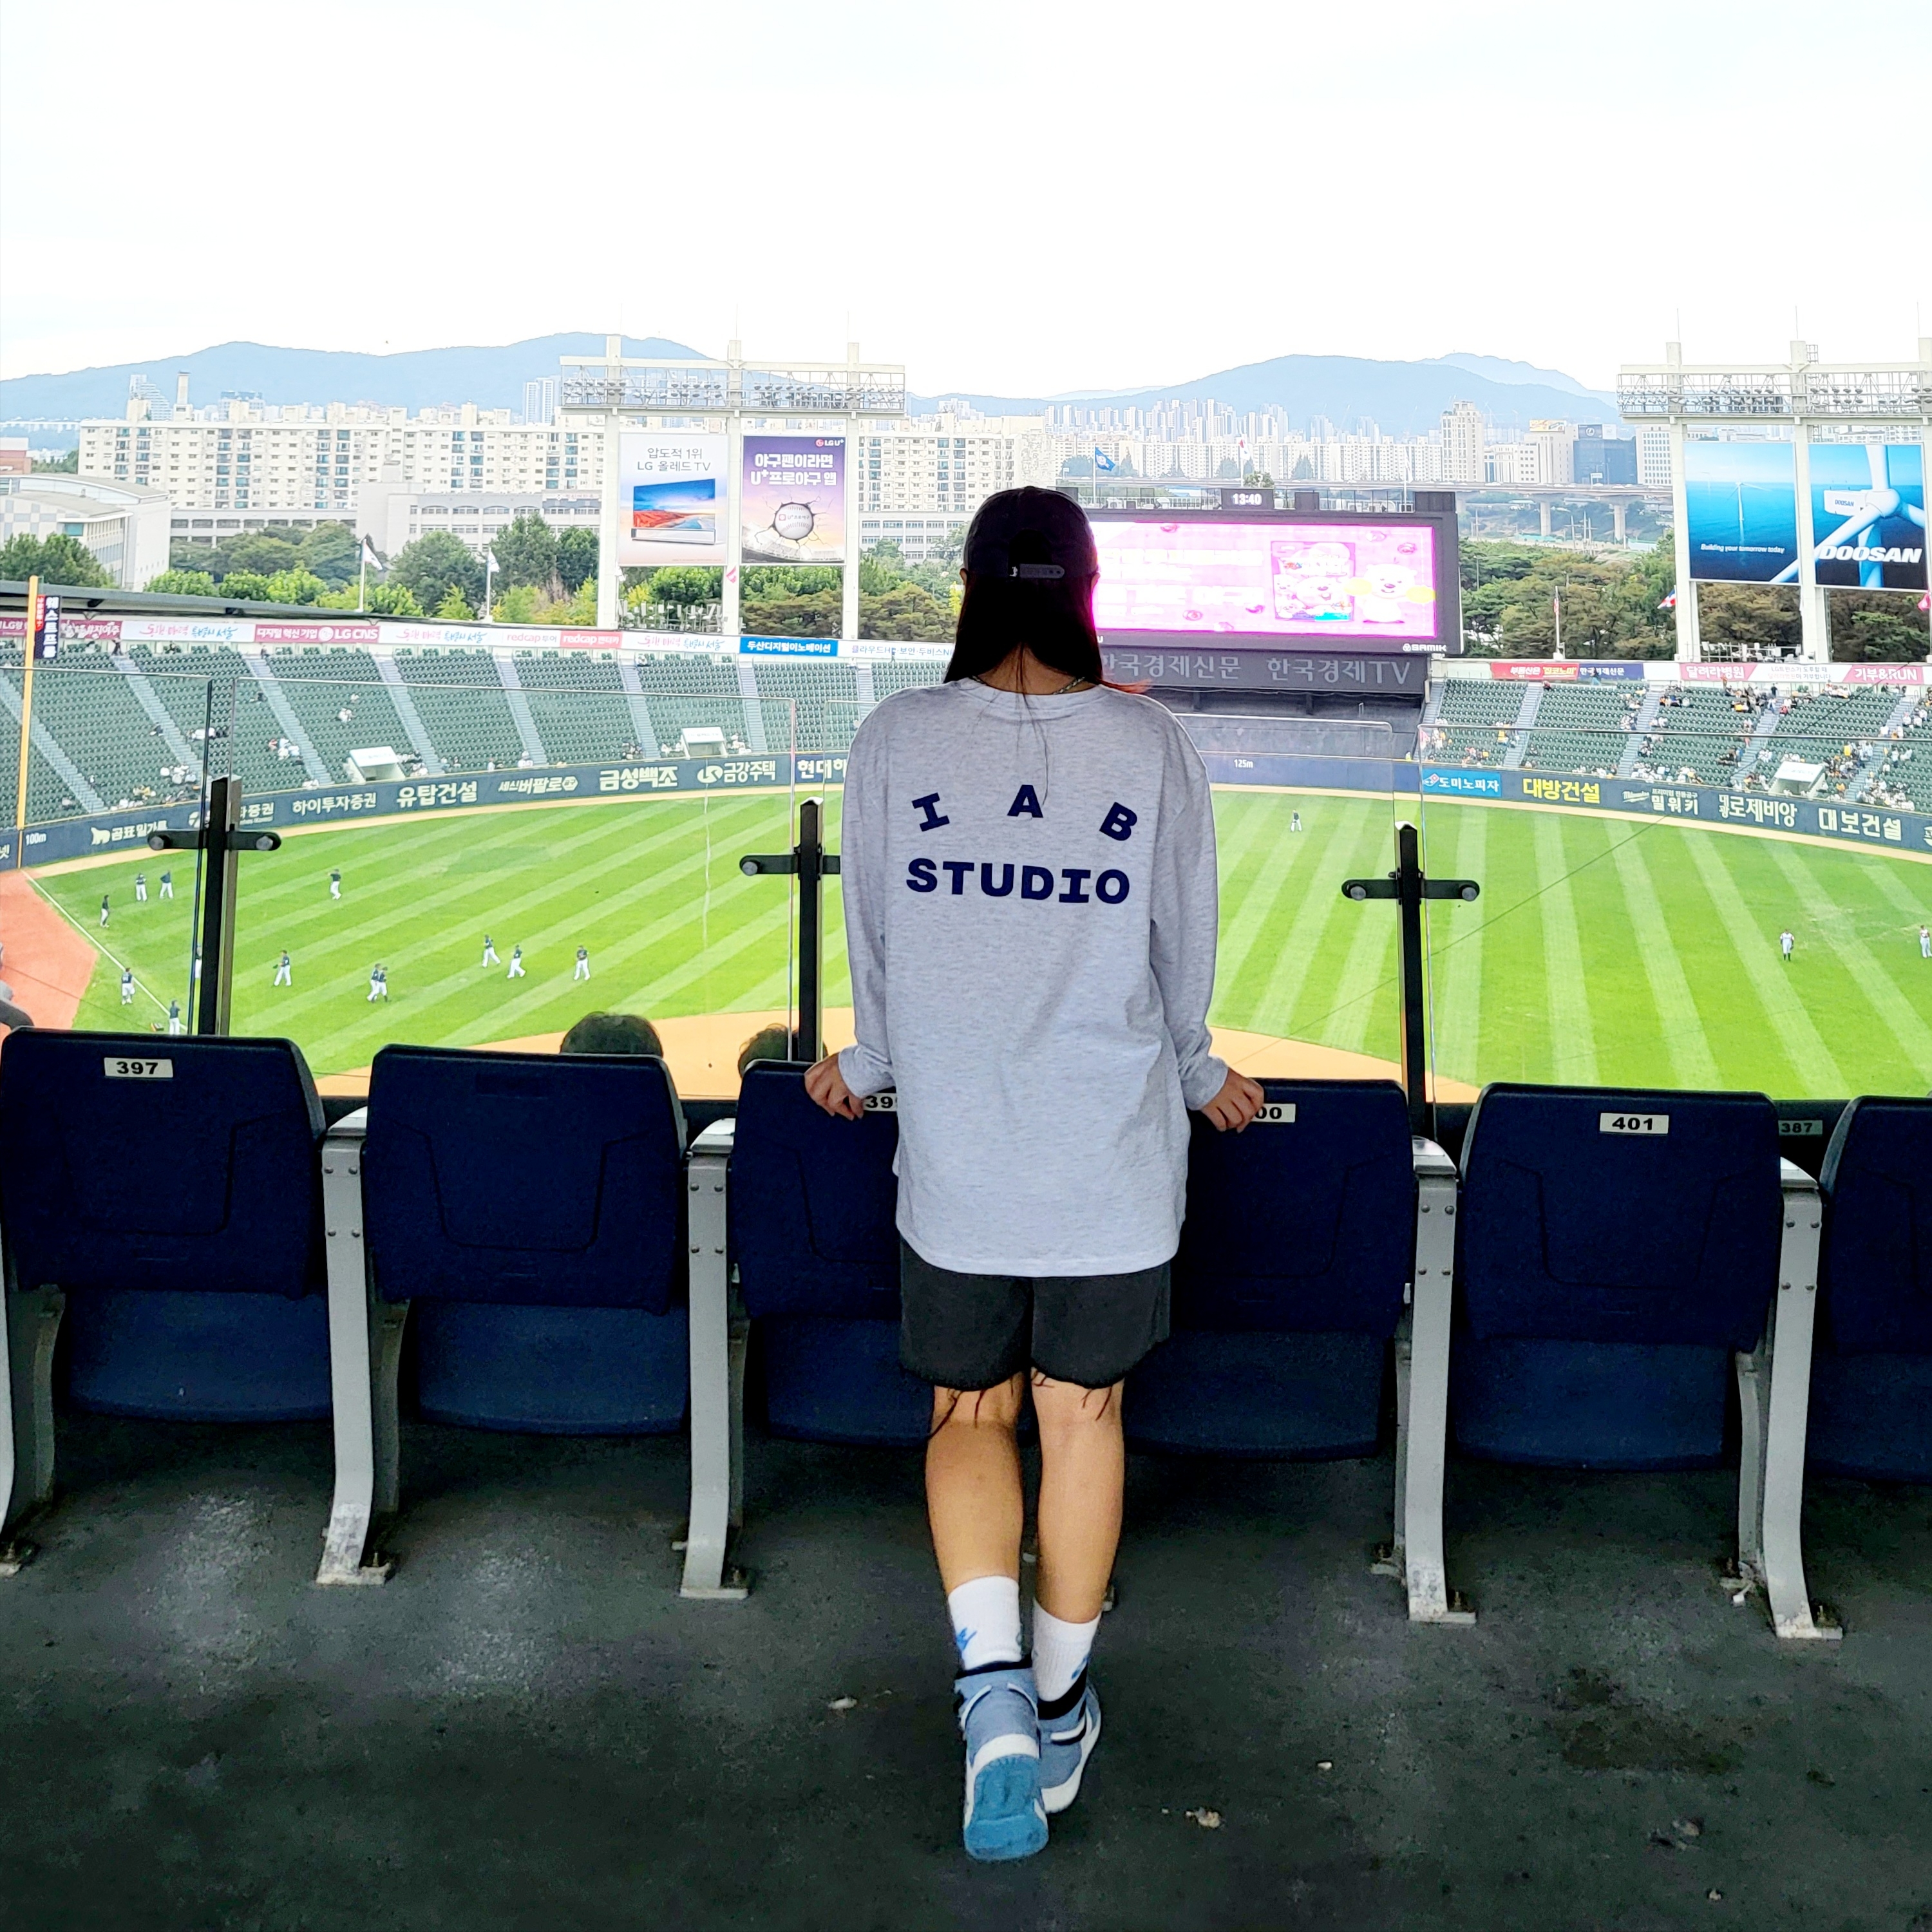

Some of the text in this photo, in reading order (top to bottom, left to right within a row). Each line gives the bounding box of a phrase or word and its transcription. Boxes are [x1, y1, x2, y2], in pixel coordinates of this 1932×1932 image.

[647, 448, 702, 459] 압도적 1위
[755, 453, 833, 468] 야구팬이라면
[638, 460, 711, 471] LG 올레드 TV
[824, 471, 837, 486] 앱
[1233, 493, 1262, 506] 13:40
[1701, 544, 1724, 553] Building
[1819, 545, 1922, 564] DOOSAN
[301, 628, 318, 639] 기업
[335, 629, 352, 639] LG
[352, 629, 379, 640] CNS
[507, 633, 541, 643] redcap
[564, 634, 597, 645] redcap
[747, 640, 831, 653] 두산디지털이노베이션
[1411, 643, 1447, 652] SAMIK
[1266, 657, 1410, 685] 한국경제TV
[1686, 665, 1745, 679] 달려라병원
[1855, 667, 1918, 681] 기부&RUN
[1234, 759, 1254, 768] 125m
[600, 766, 678, 791] 금성백조
[723, 760, 775, 784] 금강주택
[1438, 777, 1499, 793] 도미노피자
[1522, 777, 1600, 804] 대방건설
[397, 781, 478, 808] 유탑건설
[292, 792, 377, 816] 하이투자증권
[1651, 795, 1699, 815] 밀워키
[1818, 807, 1902, 841] 대보건설
[25, 832, 47, 845] 100m
[906, 858, 1130, 904] STUDIO
[117, 1061, 158, 1075] 397
[866, 1095, 897, 1108] 39
[1255, 1106, 1282, 1119] 00
[1612, 1117, 1653, 1130] 401
[1781, 1122, 1813, 1133] 387
